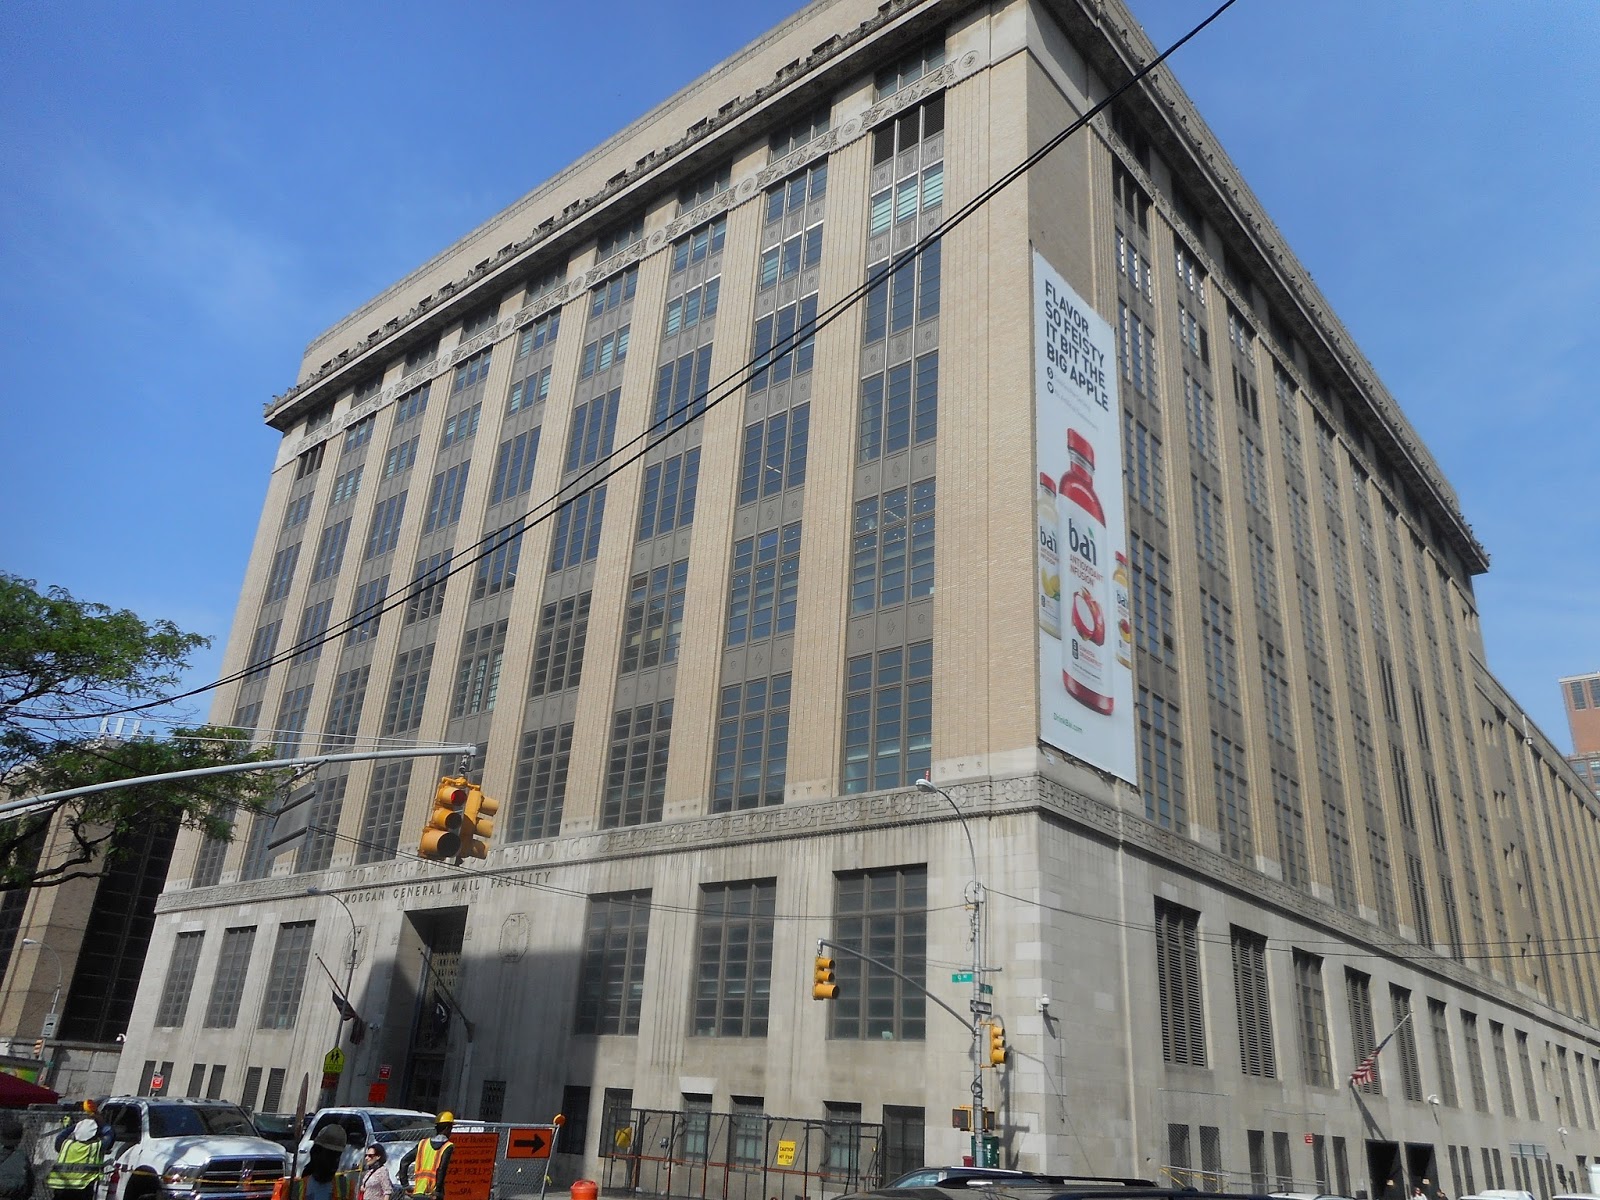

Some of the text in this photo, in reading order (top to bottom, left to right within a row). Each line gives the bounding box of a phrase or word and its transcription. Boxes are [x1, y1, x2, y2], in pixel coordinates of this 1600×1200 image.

[1045, 279, 1089, 337] FLAVOR
[1045, 300, 1104, 368] SO FEISTY
[1046, 320, 1105, 390] IT BIT THE
[1047, 341, 1067, 374] BIG
[1070, 365, 1108, 412] APPLE
[1068, 518, 1097, 566] bai
[343, 871, 551, 904] MORGAN GENERAL MAIL FACILITY
